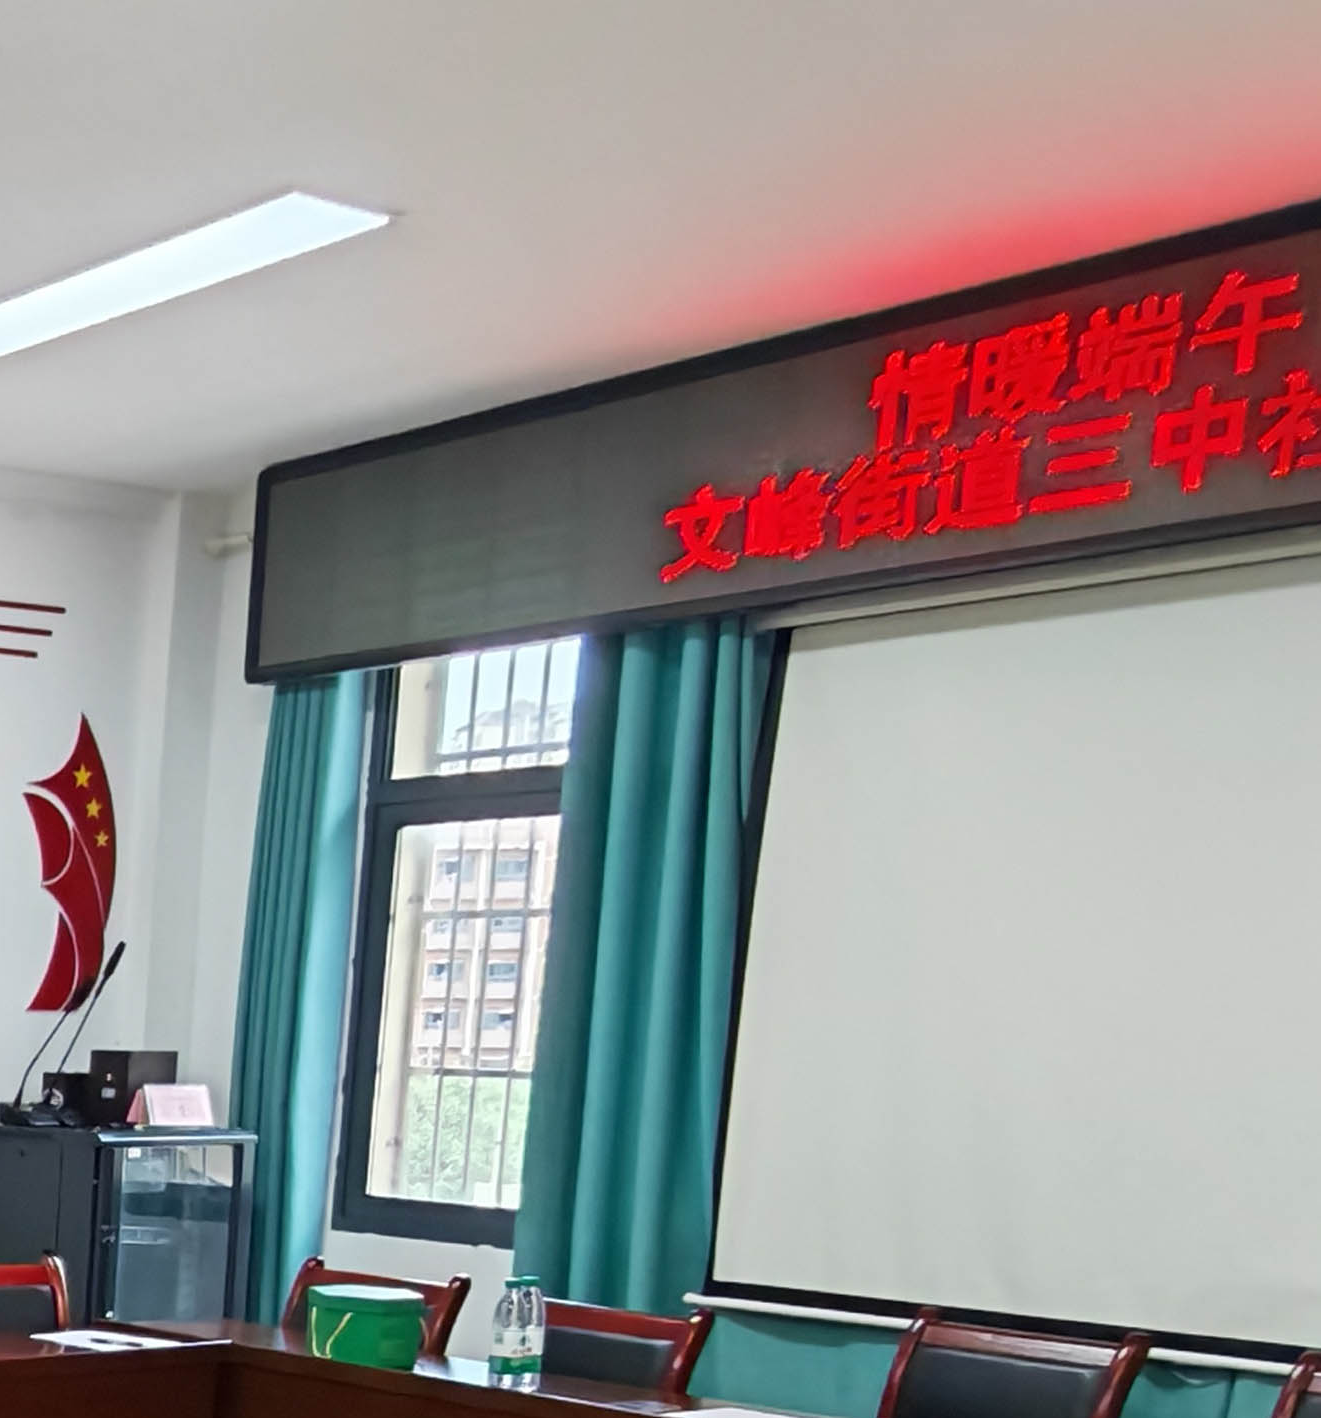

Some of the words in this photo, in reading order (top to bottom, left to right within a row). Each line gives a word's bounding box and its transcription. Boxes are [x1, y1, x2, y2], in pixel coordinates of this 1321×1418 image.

[868, 270, 1303, 453] 情暖端午
[660, 369, 1321, 583] 文峰街道三中社
